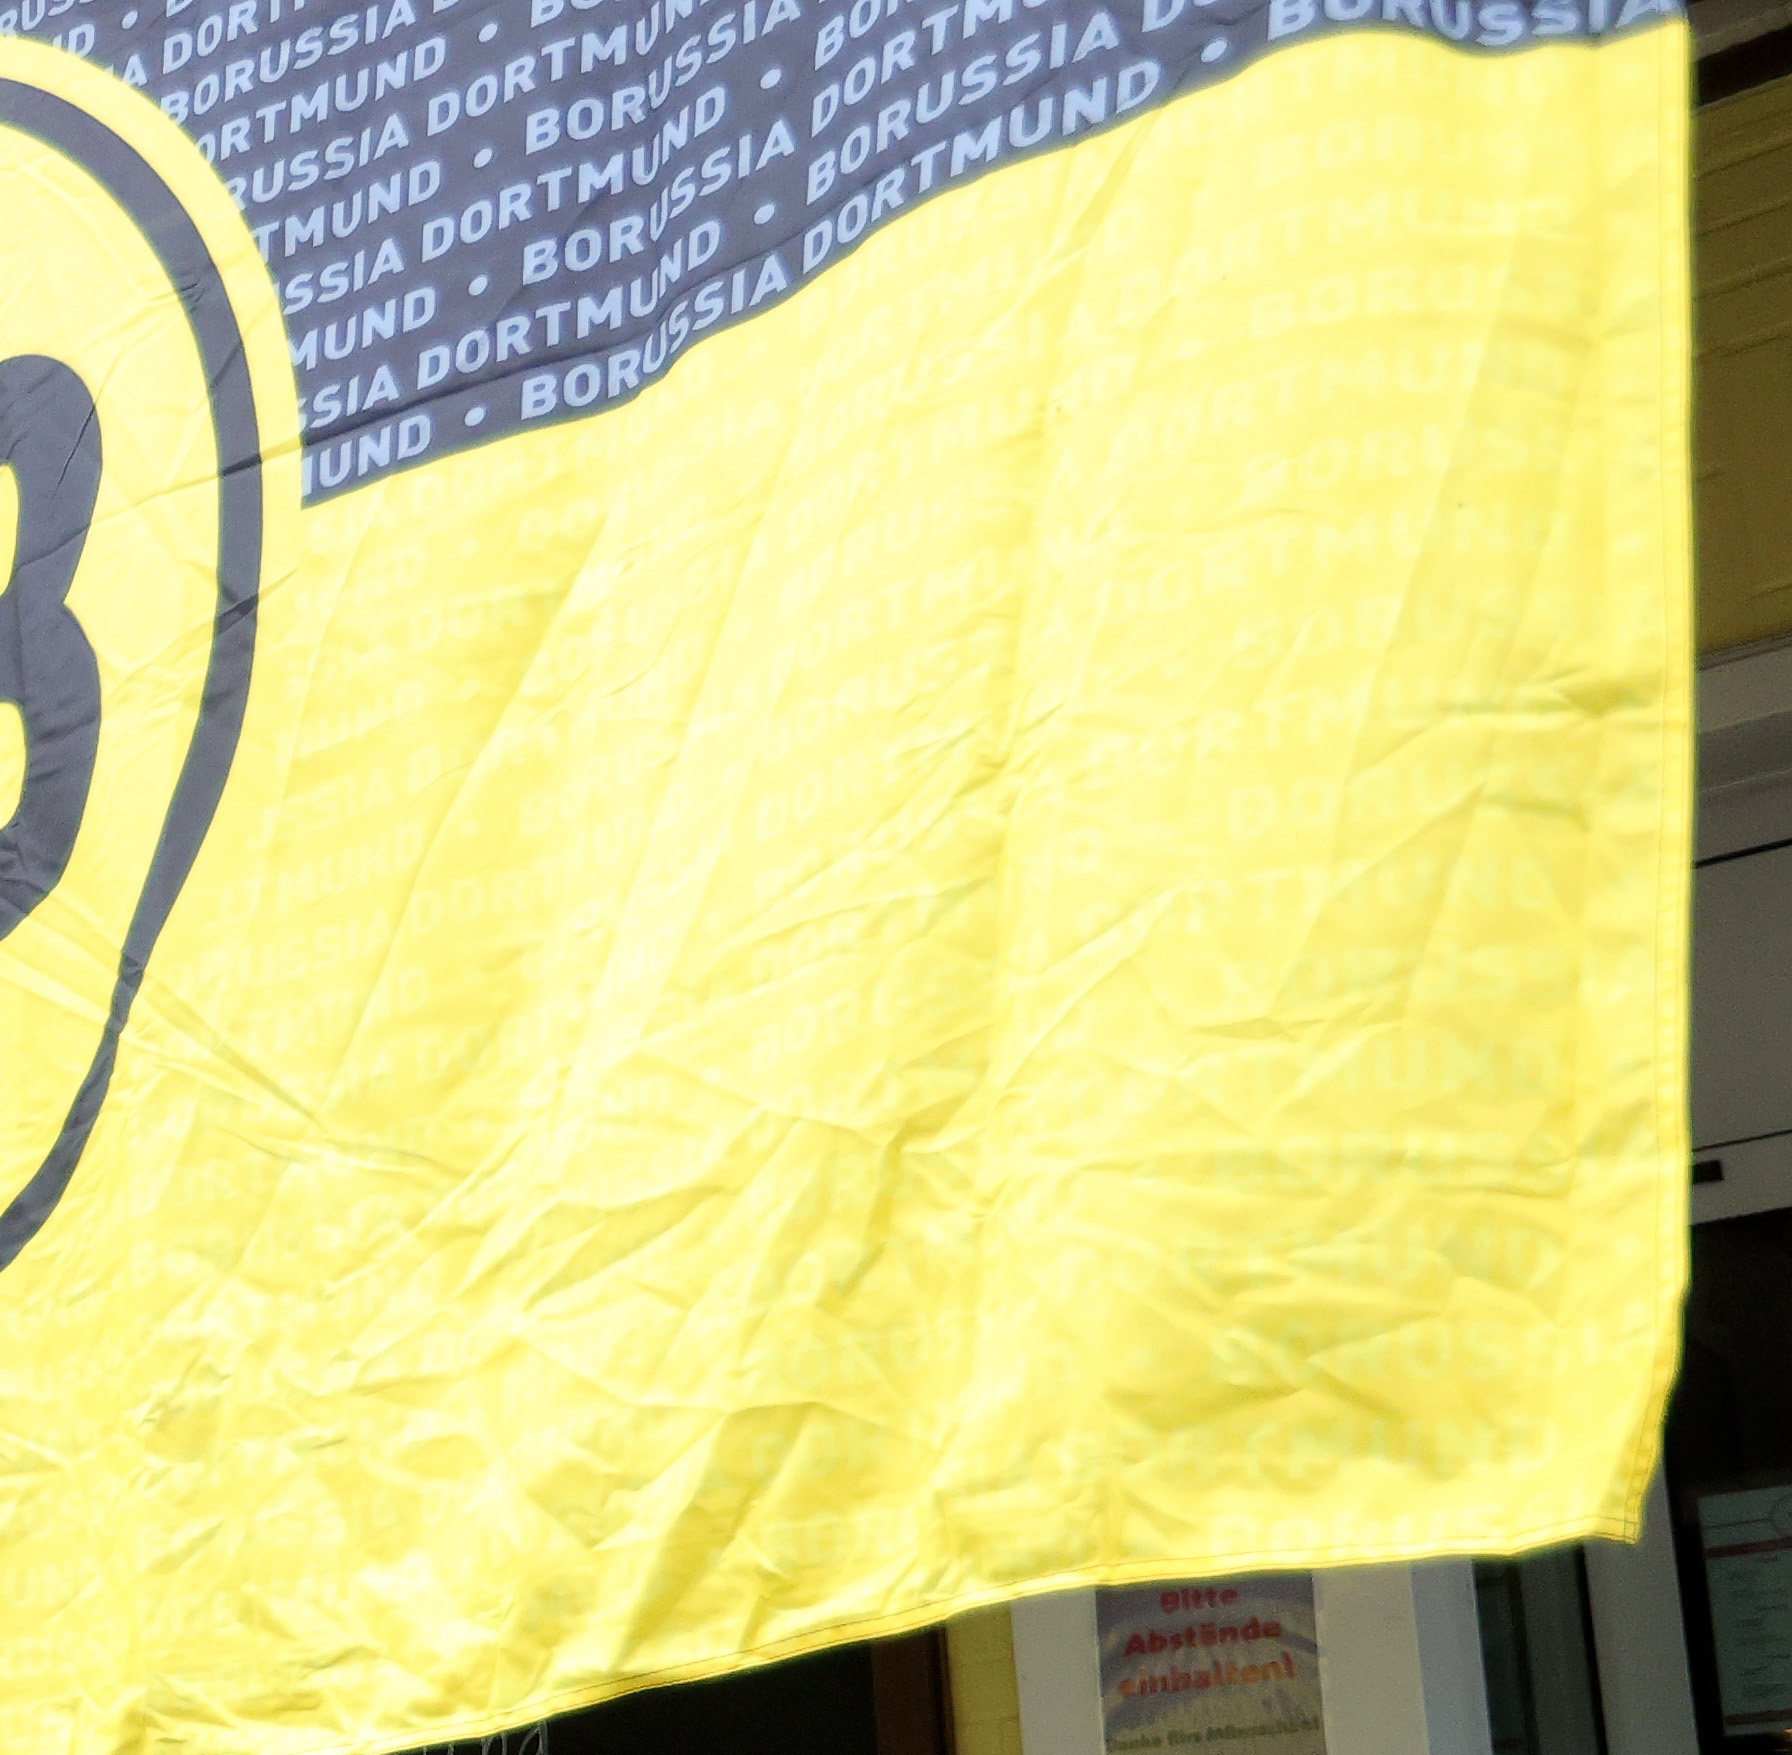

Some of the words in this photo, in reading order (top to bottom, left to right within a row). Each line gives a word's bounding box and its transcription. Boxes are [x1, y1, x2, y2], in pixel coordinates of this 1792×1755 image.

[160, 0, 416, 126] BORUSSIA
[525, 0, 802, 156] BORUSSIA
[416, 219, 723, 391] DORTMUND
[807, 10, 1120, 205] BORUSSIA
[422, 86, 726, 263] DORTMUND
[521, 252, 787, 420] BORUSSIA
[803, 61, 1161, 275] DORTMUND
[522, 118, 797, 286] BORUSSIA
